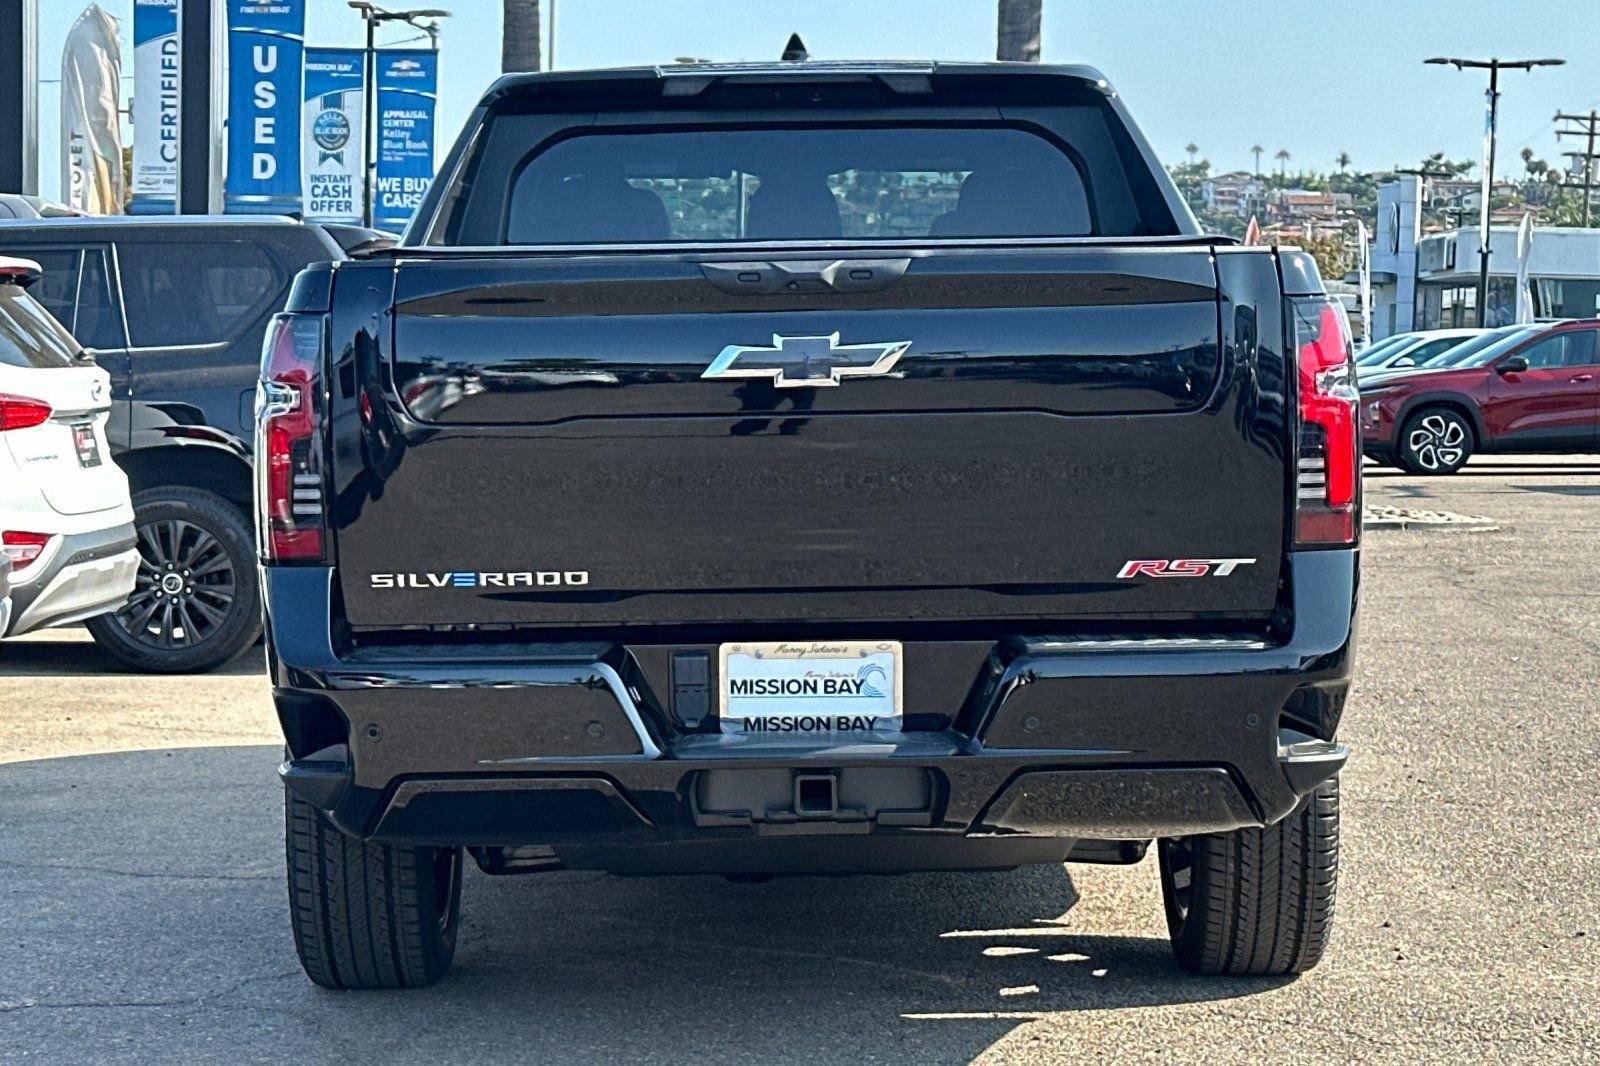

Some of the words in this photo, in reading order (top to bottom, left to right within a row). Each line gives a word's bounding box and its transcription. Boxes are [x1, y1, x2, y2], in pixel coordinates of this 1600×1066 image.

[160, 38, 177, 163] CERTIFIED
[252, 45, 278, 180] USED
[383, 110, 428, 119] APPRAISAL
[383, 119, 415, 128] CENTER
[383, 129, 411, 140] Kelley
[383, 140, 404, 149] Blue
[405, 140, 428, 149] Book
[70, 131, 84, 207] ROLET
[310, 174, 352, 184] INSTANT
[378, 177, 402, 192] WE
[311, 184, 352, 198] CASH
[310, 200, 352, 213] OFFER
[383, 193, 423, 207] CARS
[1116, 558, 1257, 579] RST
[370, 570, 590, 588] SILVERADO
[730, 679, 821, 695] MISSION
[823, 679, 865, 695] BAY
[744, 716, 831, 732] MISSION
[836, 716, 878, 731] BAY
